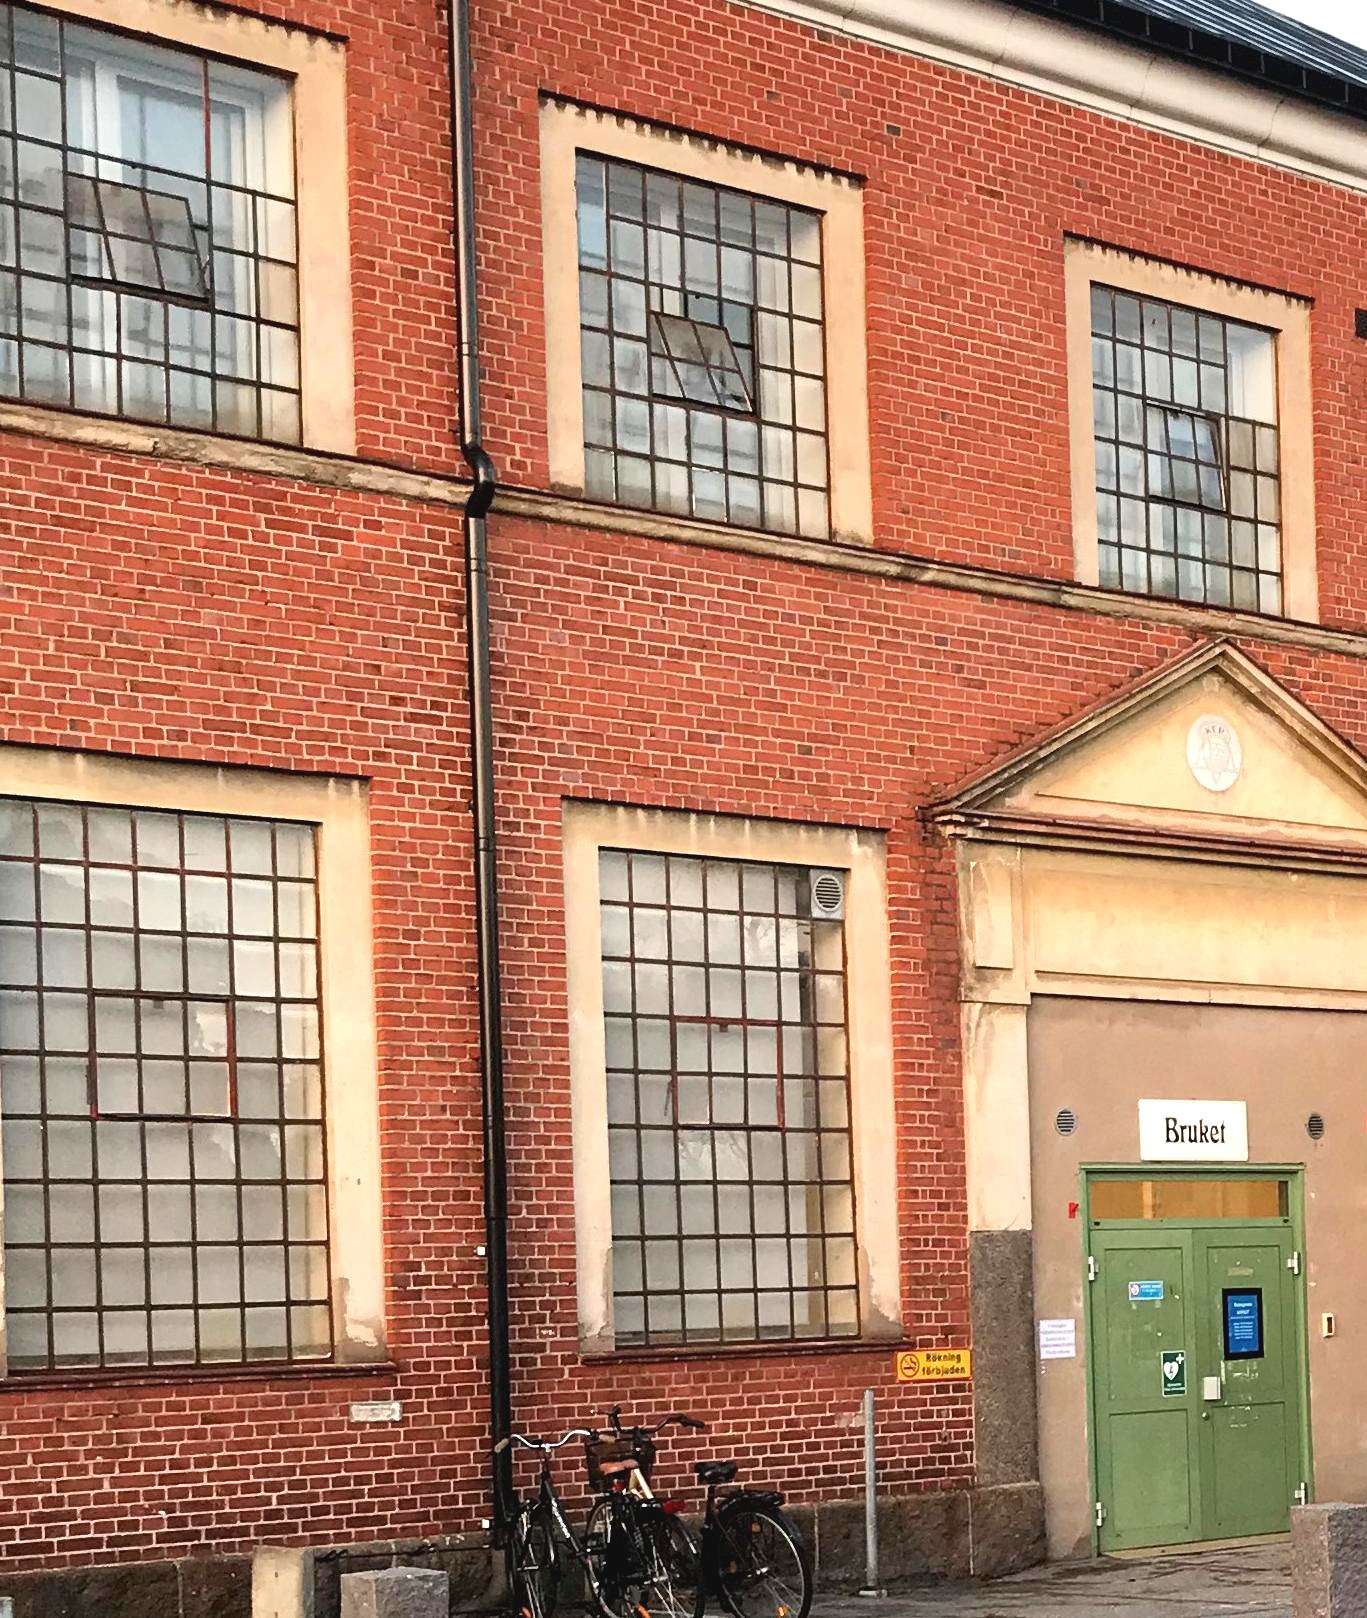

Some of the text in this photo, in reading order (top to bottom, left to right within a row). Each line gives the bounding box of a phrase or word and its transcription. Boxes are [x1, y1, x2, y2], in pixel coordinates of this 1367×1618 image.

[1165, 1117, 1226, 1144] Bruket
[926, 1353, 962, 1363] Rökning
[922, 1365, 966, 1376] förbjuden
